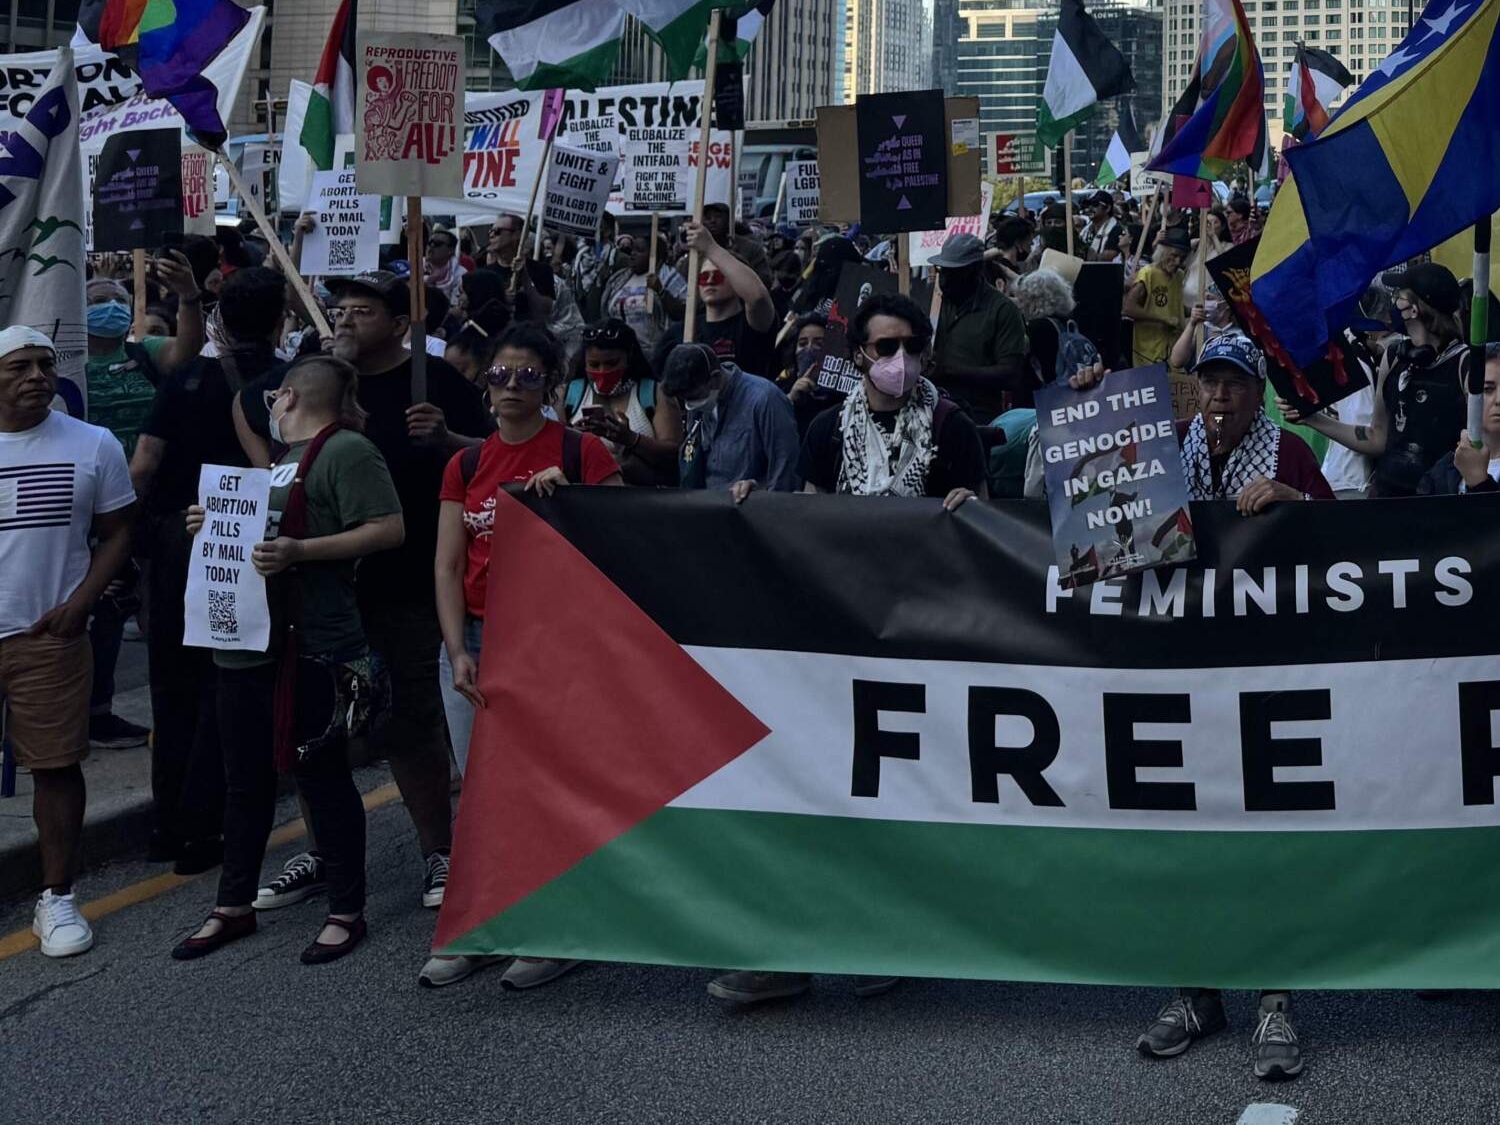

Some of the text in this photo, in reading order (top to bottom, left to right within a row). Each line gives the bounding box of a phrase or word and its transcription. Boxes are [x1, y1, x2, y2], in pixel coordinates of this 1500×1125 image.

[366, 45, 457, 62] REPRODUCTIVE
[403, 60, 457, 91] FREEDOM
[418, 91, 455, 124] FOR
[570, 117, 615, 133] GLOBALIZE
[585, 130, 600, 143] THE
[629, 129, 686, 141] GLOBALIZE
[902, 135, 923, 147] QUEER
[401, 123, 456, 165] ALL!
[647, 142, 666, 154] THE
[555, 151, 609, 175] UNITE &
[633, 155, 680, 167] INTIFADA
[799, 163, 819, 176] FUL
[903, 162, 920, 173] FREE
[558, 171, 597, 193] FIGHT
[635, 172, 677, 182] FIGHT THE
[636, 182, 675, 192] U.S. WAR
[329, 200, 359, 209] PILLS
[634, 192, 677, 202] MACHINE!
[320, 213, 365, 223] BY MAIL
[546, 206, 598, 227] BERATION!
[326, 226, 361, 236] TODAY
[1050, 386, 1157, 428] END THE
[1045, 419, 1173, 465] GENOCIDE
[219, 475, 242, 492] GET
[1063, 458, 1167, 498] IN GAZA
[206, 496, 257, 517] ABORTION
[1086, 499, 1153, 531] NOW!
[210, 520, 241, 538] PILLS
[202, 542, 246, 563] BY MAIL
[205, 565, 240, 585] TODAY
[1045, 555, 1473, 618] FEMINISTS
[850, 678, 1337, 812] FREE
